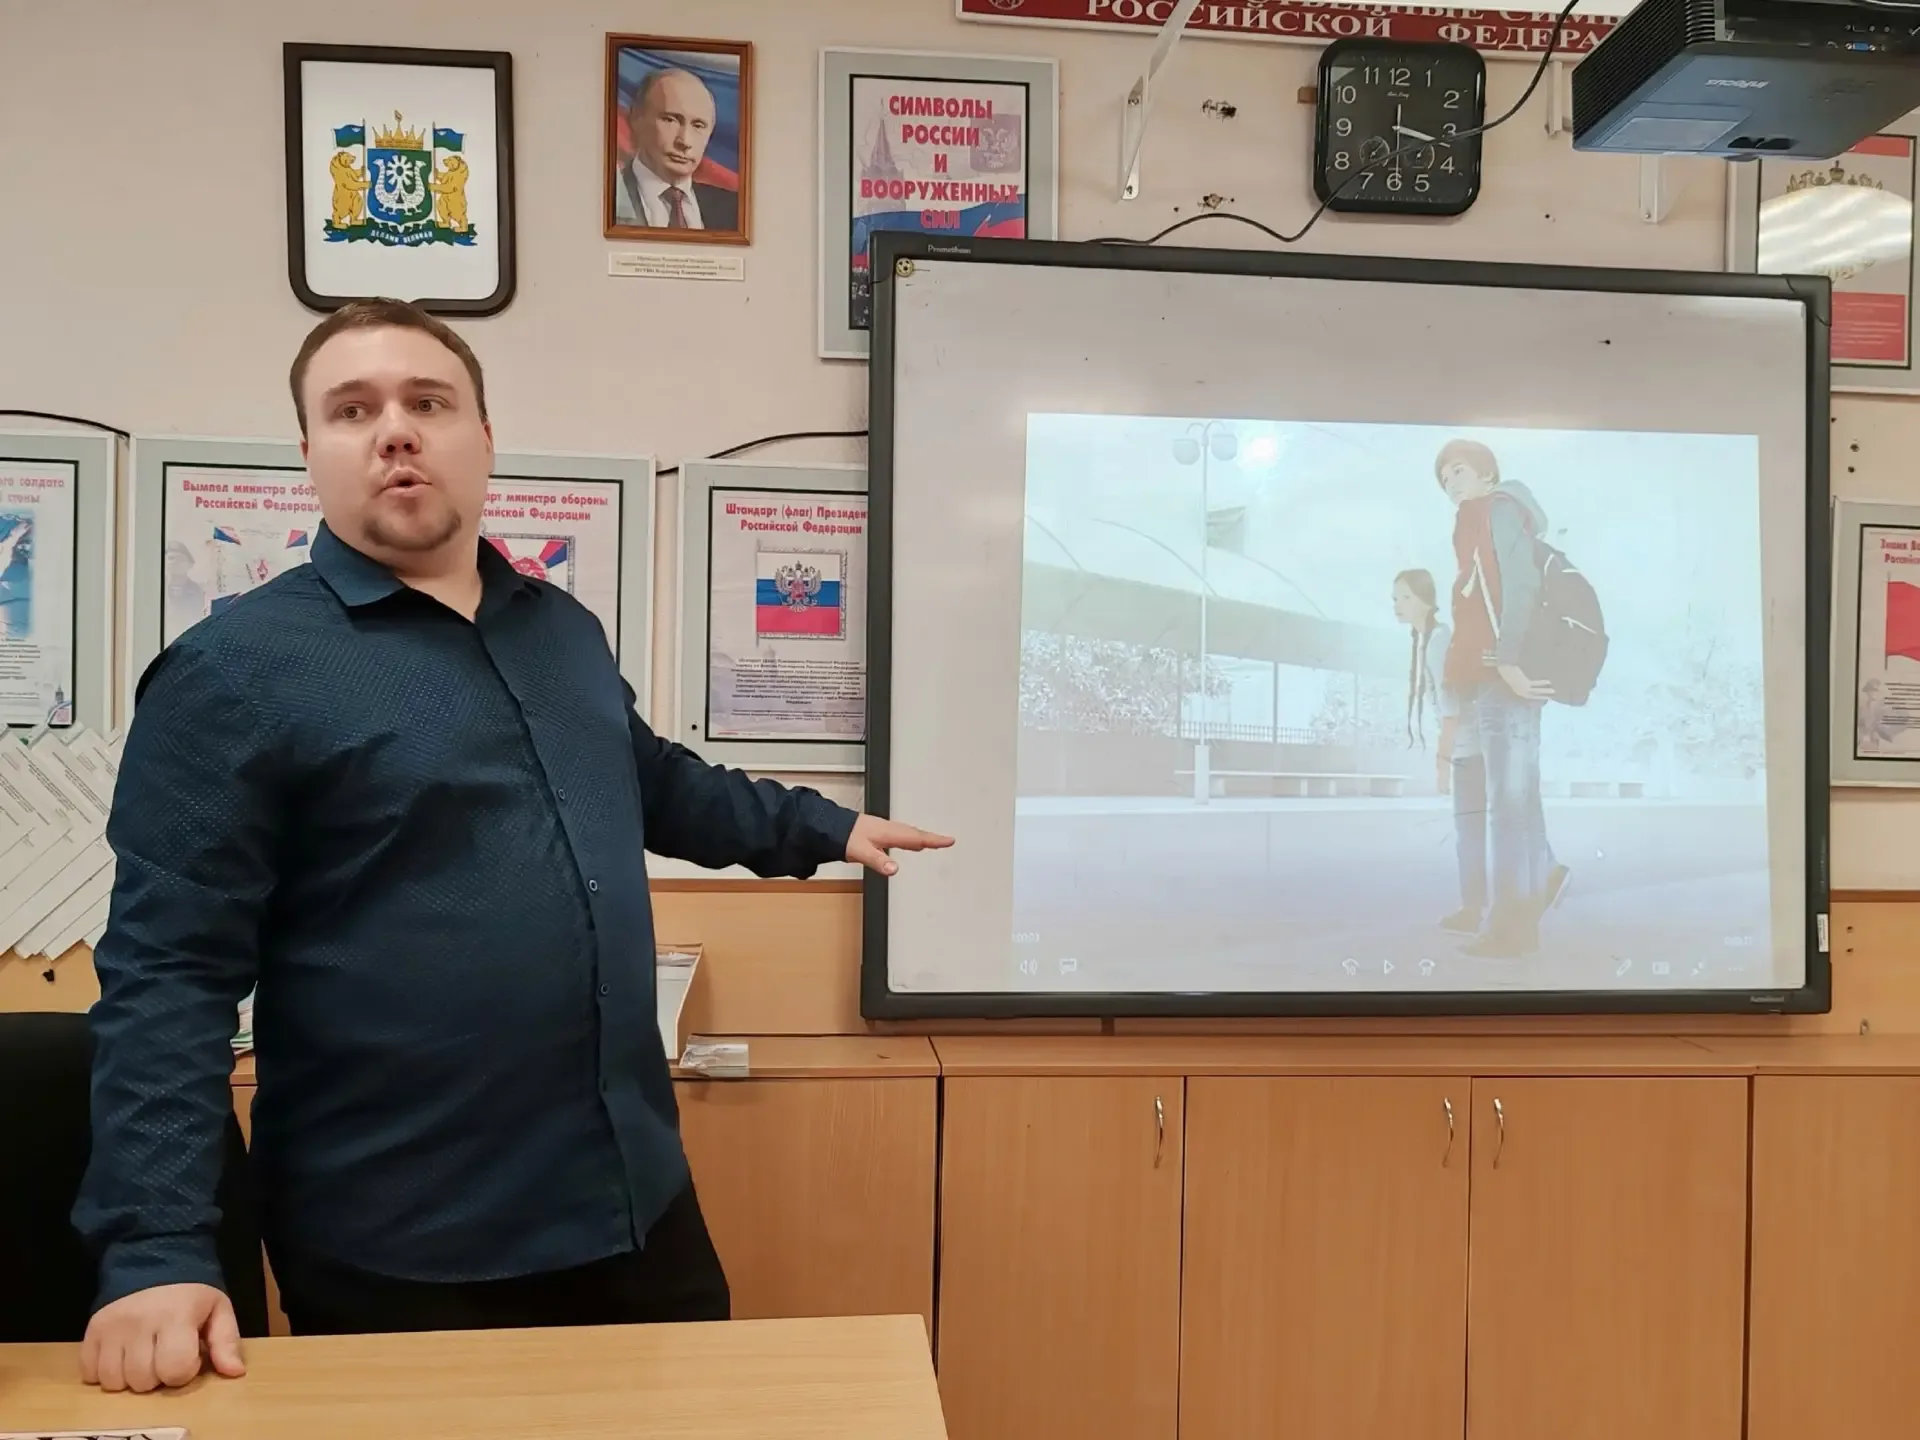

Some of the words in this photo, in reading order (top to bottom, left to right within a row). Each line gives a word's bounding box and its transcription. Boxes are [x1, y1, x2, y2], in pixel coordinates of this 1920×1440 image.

[1363, 66, 1380, 85] 11
[1388, 68, 1411, 86] 12
[1425, 69, 1432, 87] 1
[1335, 85, 1357, 104] 10
[1443, 90, 1460, 109] 2
[888, 95, 993, 119] СИМВОЛЫ
[902, 124, 980, 146] РОССИИ
[1335, 118, 1352, 136] 9
[1442, 123, 1457, 140] 3
[934, 153, 948, 174] И
[1334, 152, 1350, 170] 8
[1440, 156, 1455, 174] 4
[1360, 172, 1374, 190] 7
[1386, 173, 1403, 191] 6
[1414, 174, 1430, 192] 5
[860, 179, 1020, 204] ВООРУЖЕННЫХ
[920, 208, 961, 229] СИЛ
[183, 480, 229, 493] Вымпел
[233, 484, 286, 497] министра
[195, 496, 258, 510] Российской
[506, 494, 557, 506] министра
[561, 493, 609, 508] обороны
[529, 507, 591, 521] Федерации
[725, 503, 778, 518] Штандарт
[816, 506, 869, 520] Президен
[740, 519, 798, 533] Российской
[802, 521, 862, 535] Федерации
